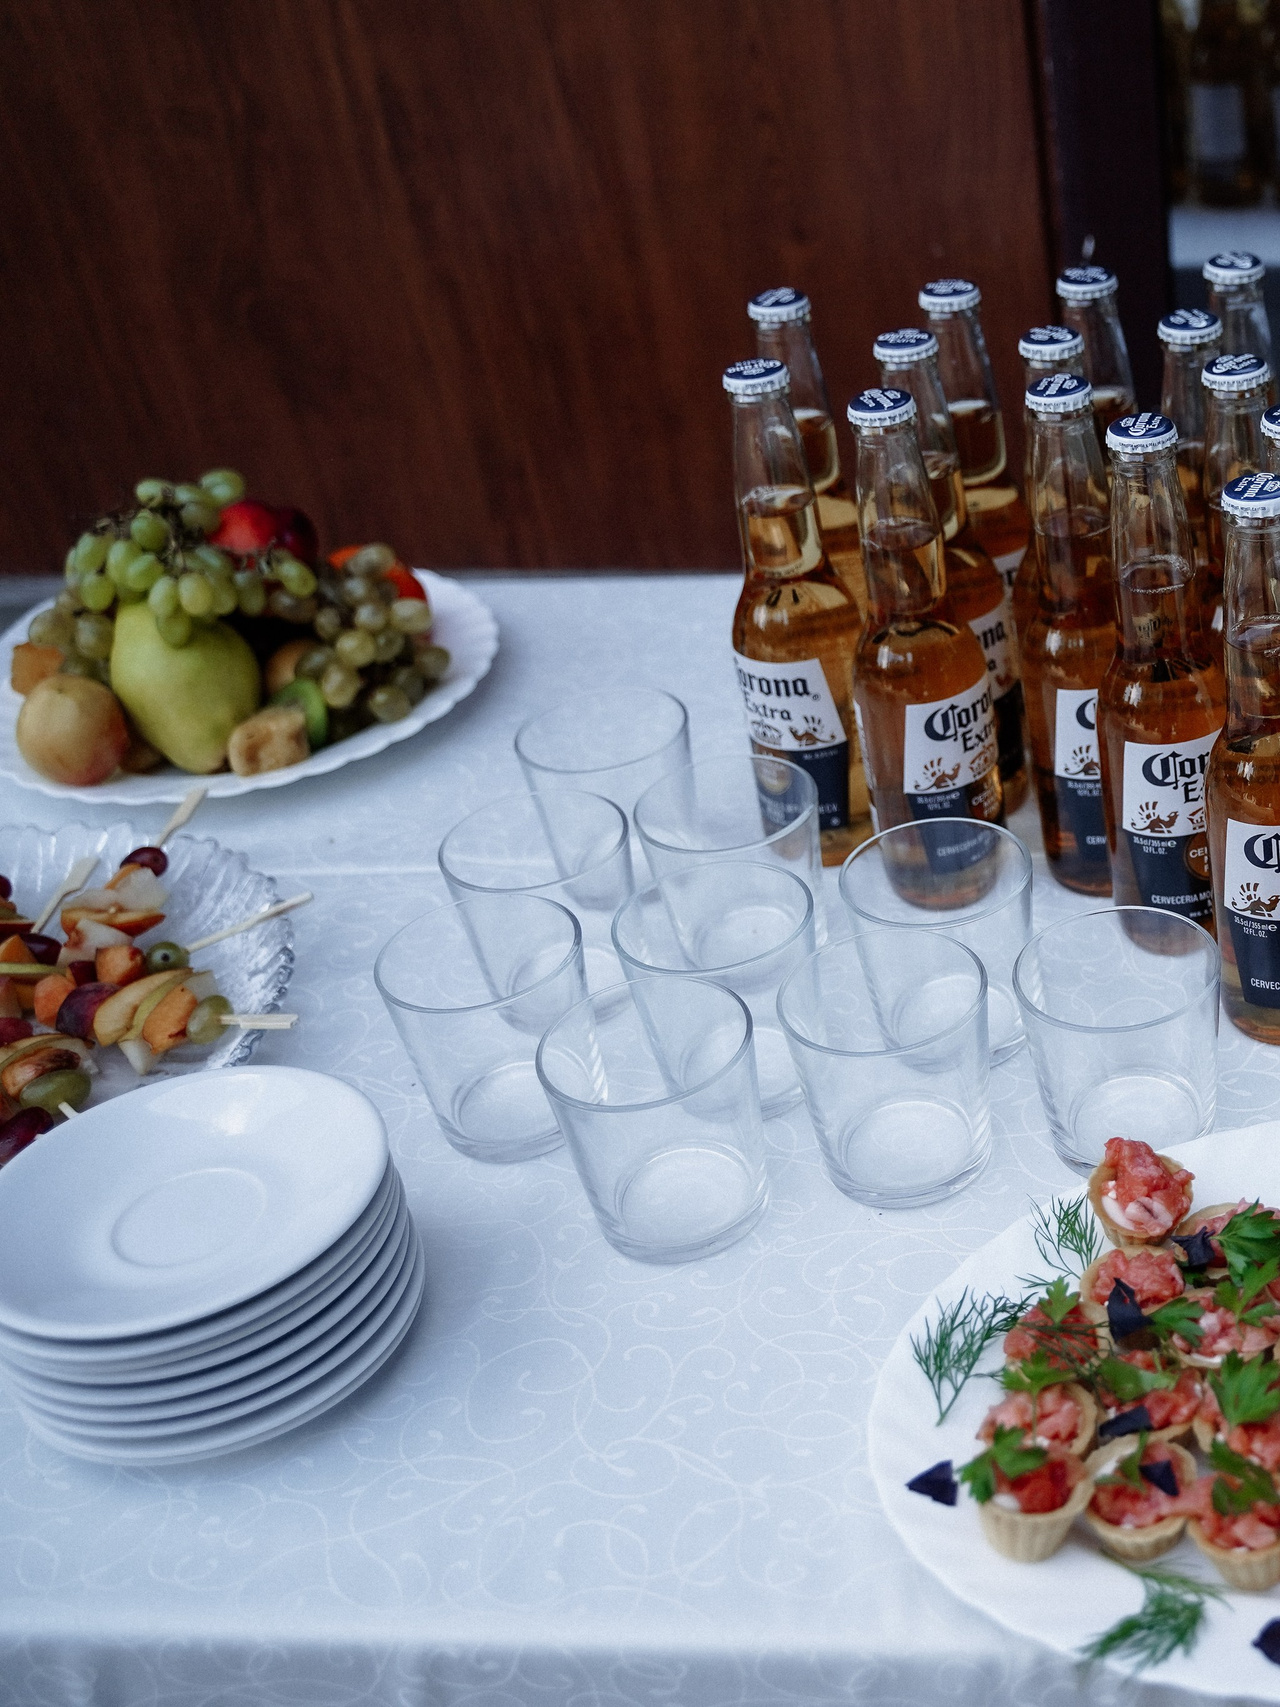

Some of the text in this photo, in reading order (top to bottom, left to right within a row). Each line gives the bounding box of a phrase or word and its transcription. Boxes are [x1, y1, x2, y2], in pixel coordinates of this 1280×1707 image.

[1241, 472, 1275, 499] Corona
[737, 664, 811, 698] orona
[1142, 750, 1211, 790] Cor
[1151, 893, 1198, 905] CERVECERIA
